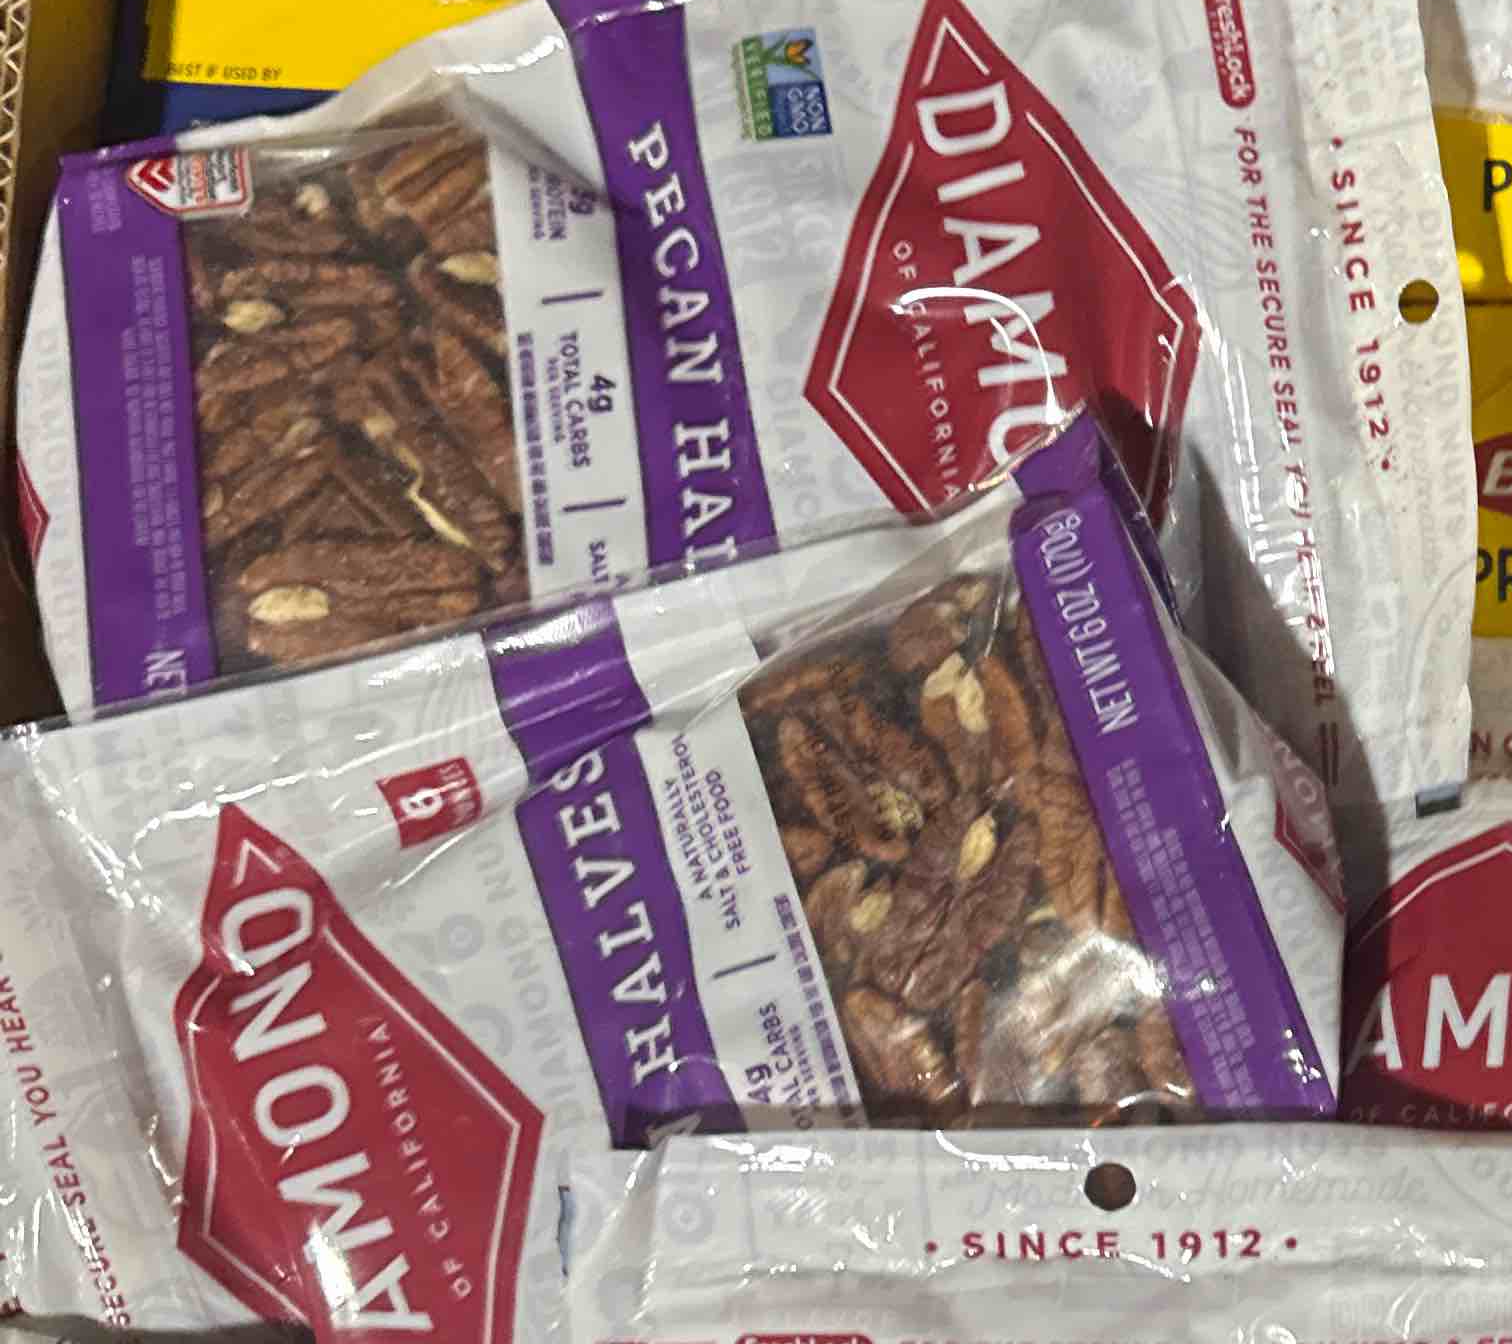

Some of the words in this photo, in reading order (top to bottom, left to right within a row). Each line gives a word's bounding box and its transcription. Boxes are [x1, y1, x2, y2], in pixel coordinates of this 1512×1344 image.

[802, 85, 828, 131] NON
[1235, 126, 1261, 184] FOR
[1245, 194, 1273, 248] THE
[1255, 257, 1291, 370] SECURE
[1329, 168, 1376, 312] SINCE
[1353, 340, 1391, 438] 1912
[560, 332, 581, 393] TOTAL
[892, 239, 917, 281] OF
[907, 302, 963, 500] CALIFORNIA
[586, 373, 617, 413] 4g
[565, 399, 592, 469] CARBS
[1031, 508, 1094, 585] (170g)
[1057, 582, 1100, 623] OZ
[1068, 617, 1107, 641] 6
[1076, 639, 1121, 686] WT
[1089, 680, 1140, 735] NET
[551, 748, 676, 1087] HALVES
[759, 1001, 793, 1073] CARBS
[368, 1022, 449, 1243] CALIFORNIA
[962, 1230, 1121, 1260] SINCE
[1150, 1230, 1263, 1258] 1912
[441, 1256, 473, 1299] OF
